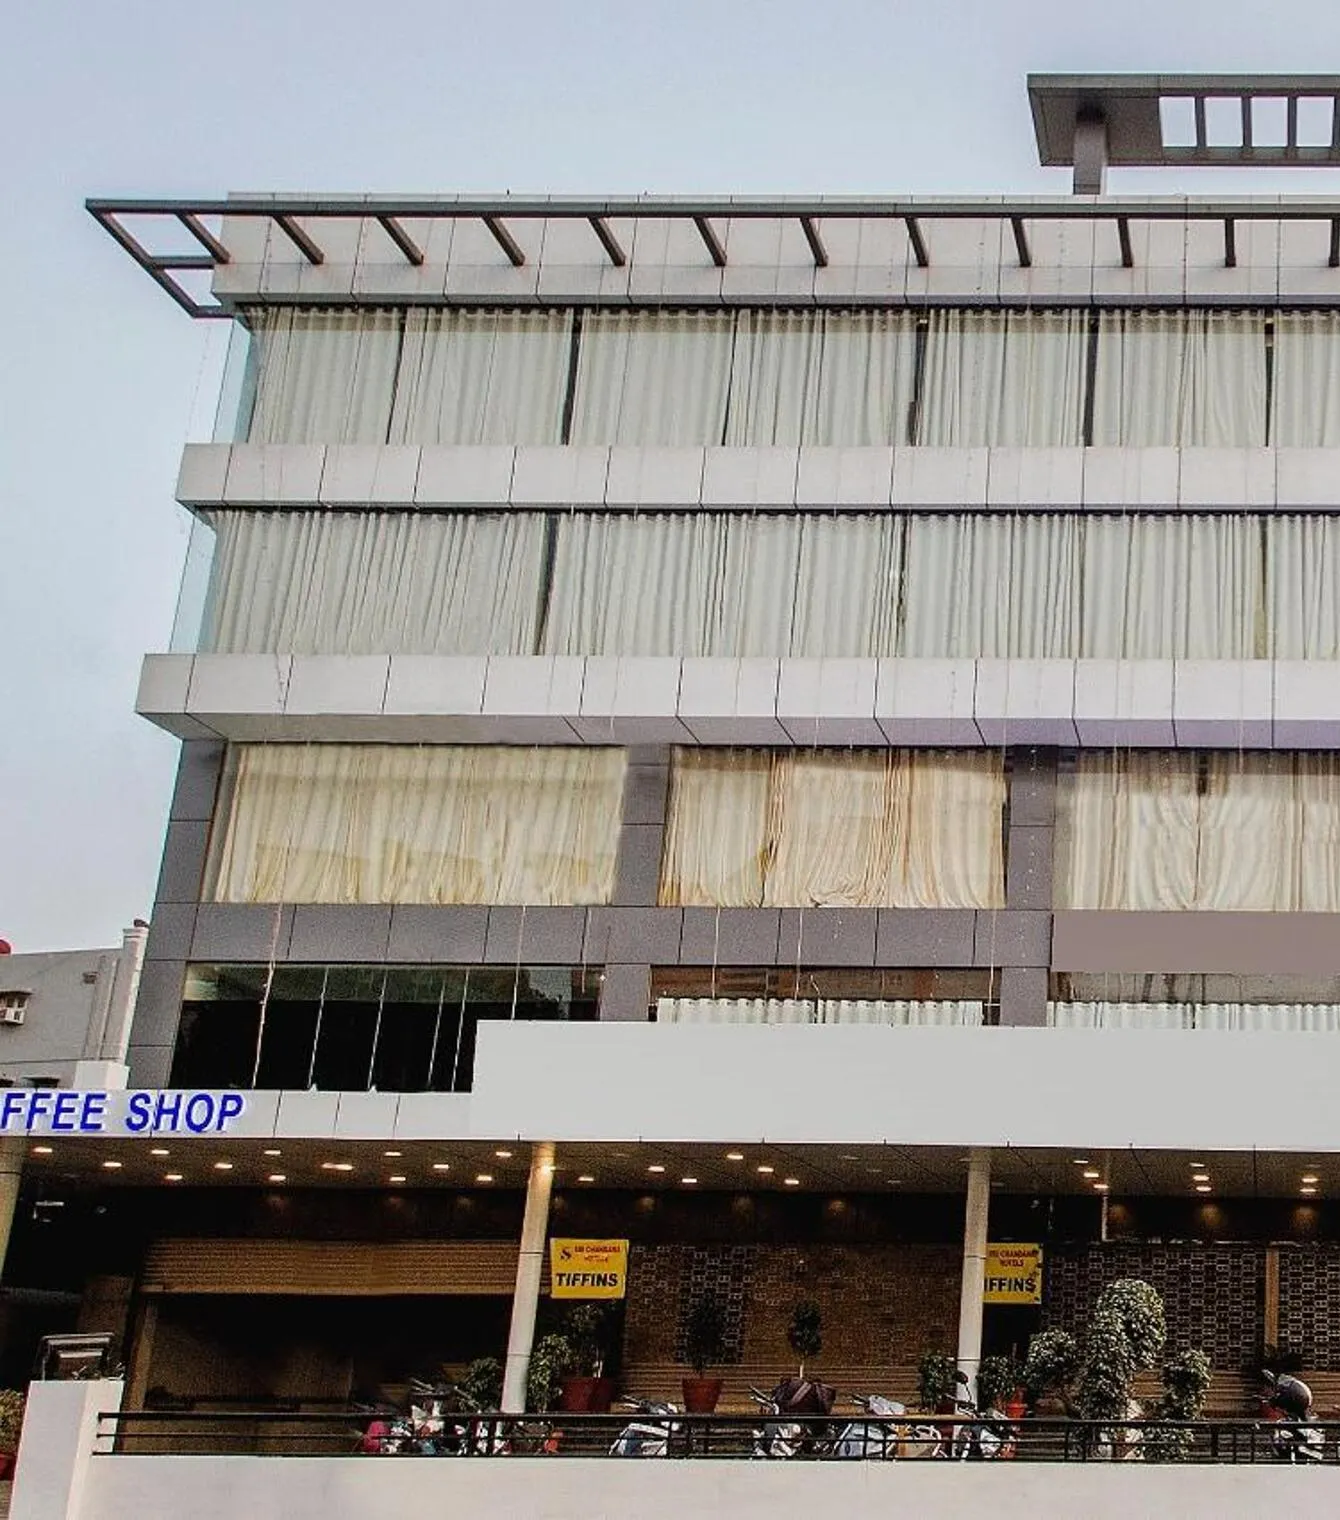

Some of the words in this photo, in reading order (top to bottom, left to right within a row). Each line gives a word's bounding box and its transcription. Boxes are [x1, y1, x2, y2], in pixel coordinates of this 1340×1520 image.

[0, 1093, 106, 1130] FFEE
[126, 1092, 243, 1132] SHOP
[556, 1272, 619, 1287] TIFFINS
[984, 1277, 1037, 1293] IFFINS
